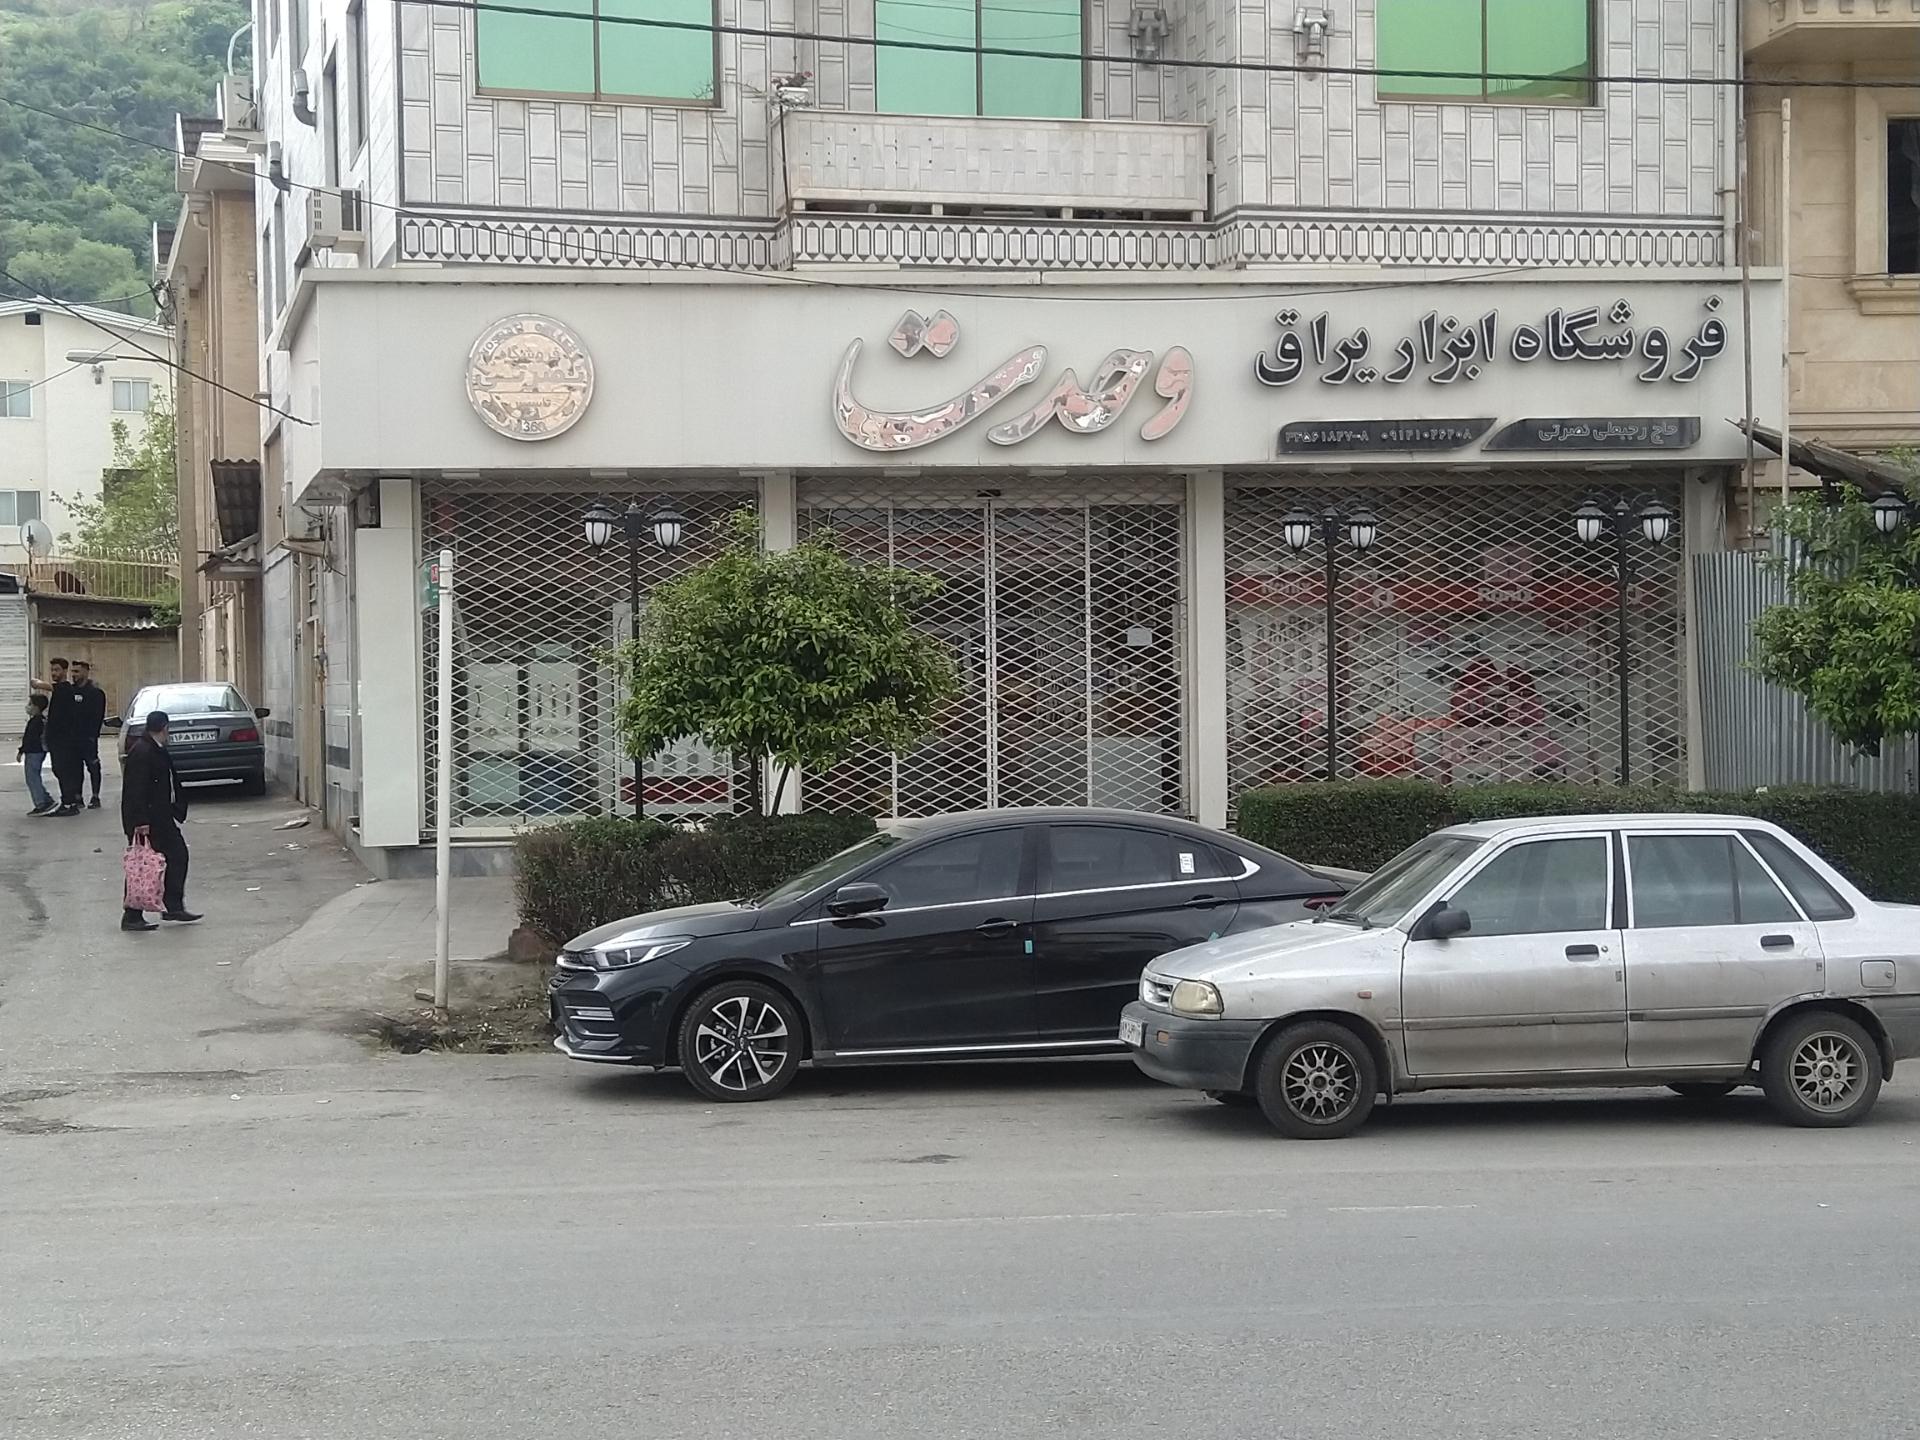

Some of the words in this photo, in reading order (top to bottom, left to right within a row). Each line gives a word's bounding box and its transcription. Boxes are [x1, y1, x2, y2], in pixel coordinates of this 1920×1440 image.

[1255, 309, 1379, 385] یراق
[1383, 308, 1500, 384] ابزار
[1511, 295, 1728, 383] فروشگاه
[1537, 423, 1591, 442] نصرتی
[1593, 421, 1648, 442] رجبعلی
[1650, 421, 1679, 445] حاج
